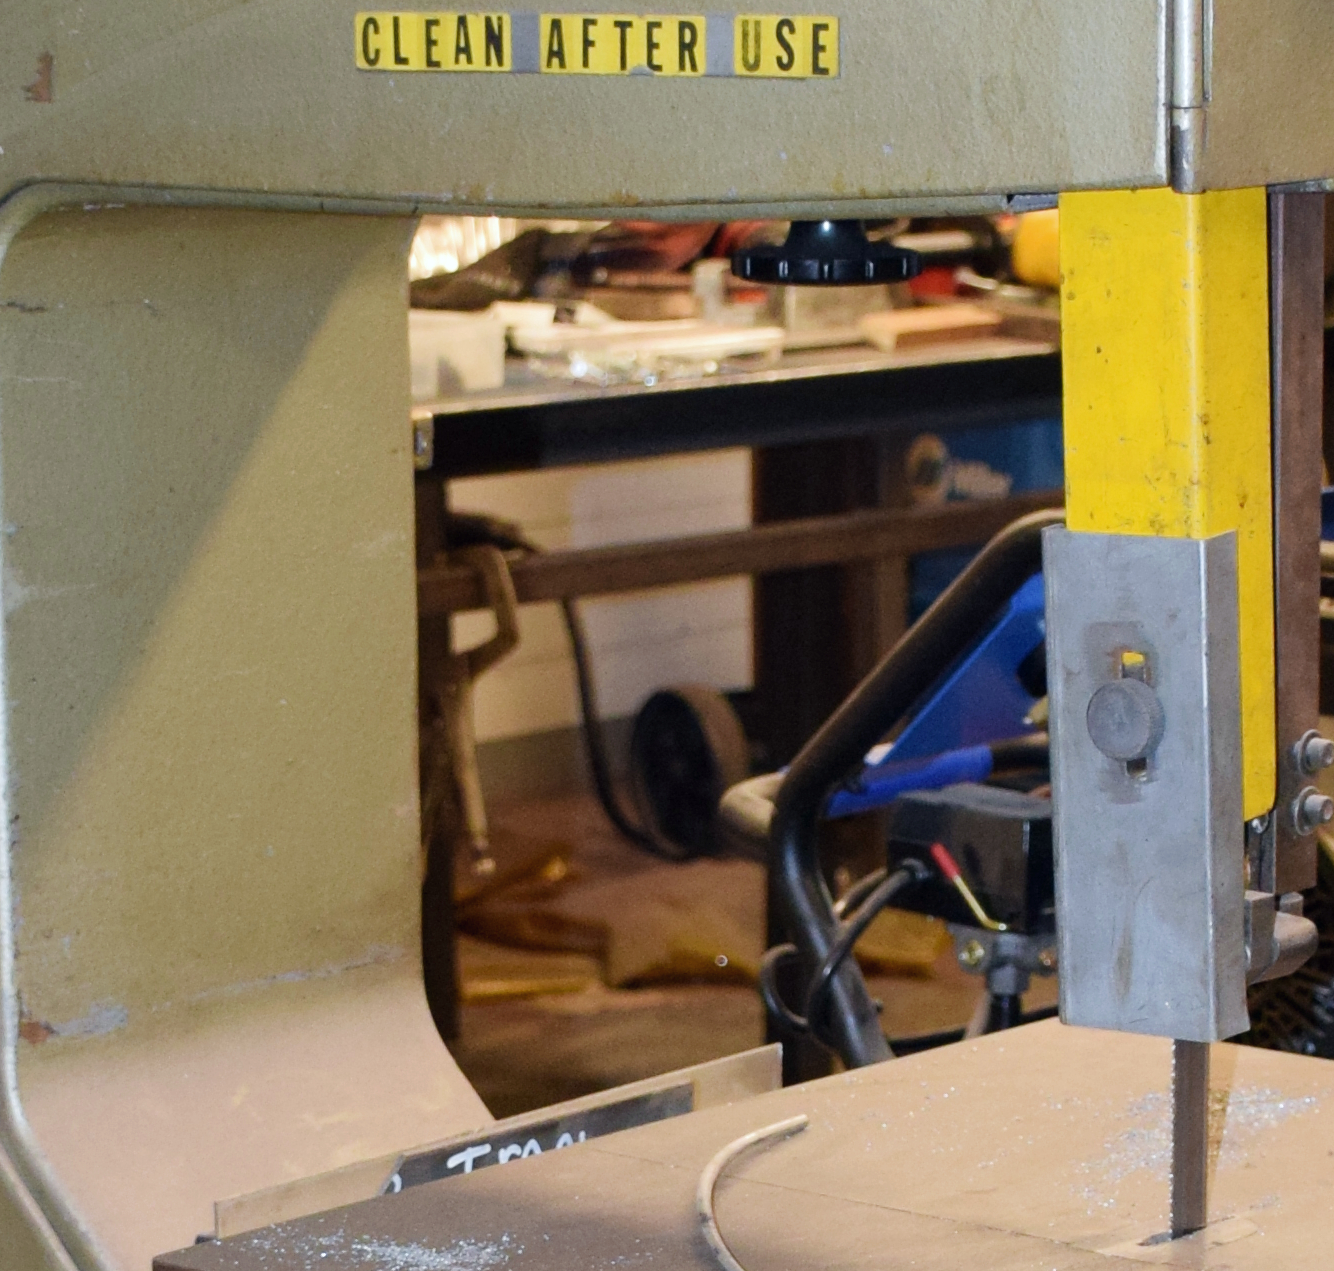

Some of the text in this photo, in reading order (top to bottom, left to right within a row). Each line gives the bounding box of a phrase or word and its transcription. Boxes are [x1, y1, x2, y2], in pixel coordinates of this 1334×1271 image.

[361, 14, 830, 75] CLEAN AFTER USE
